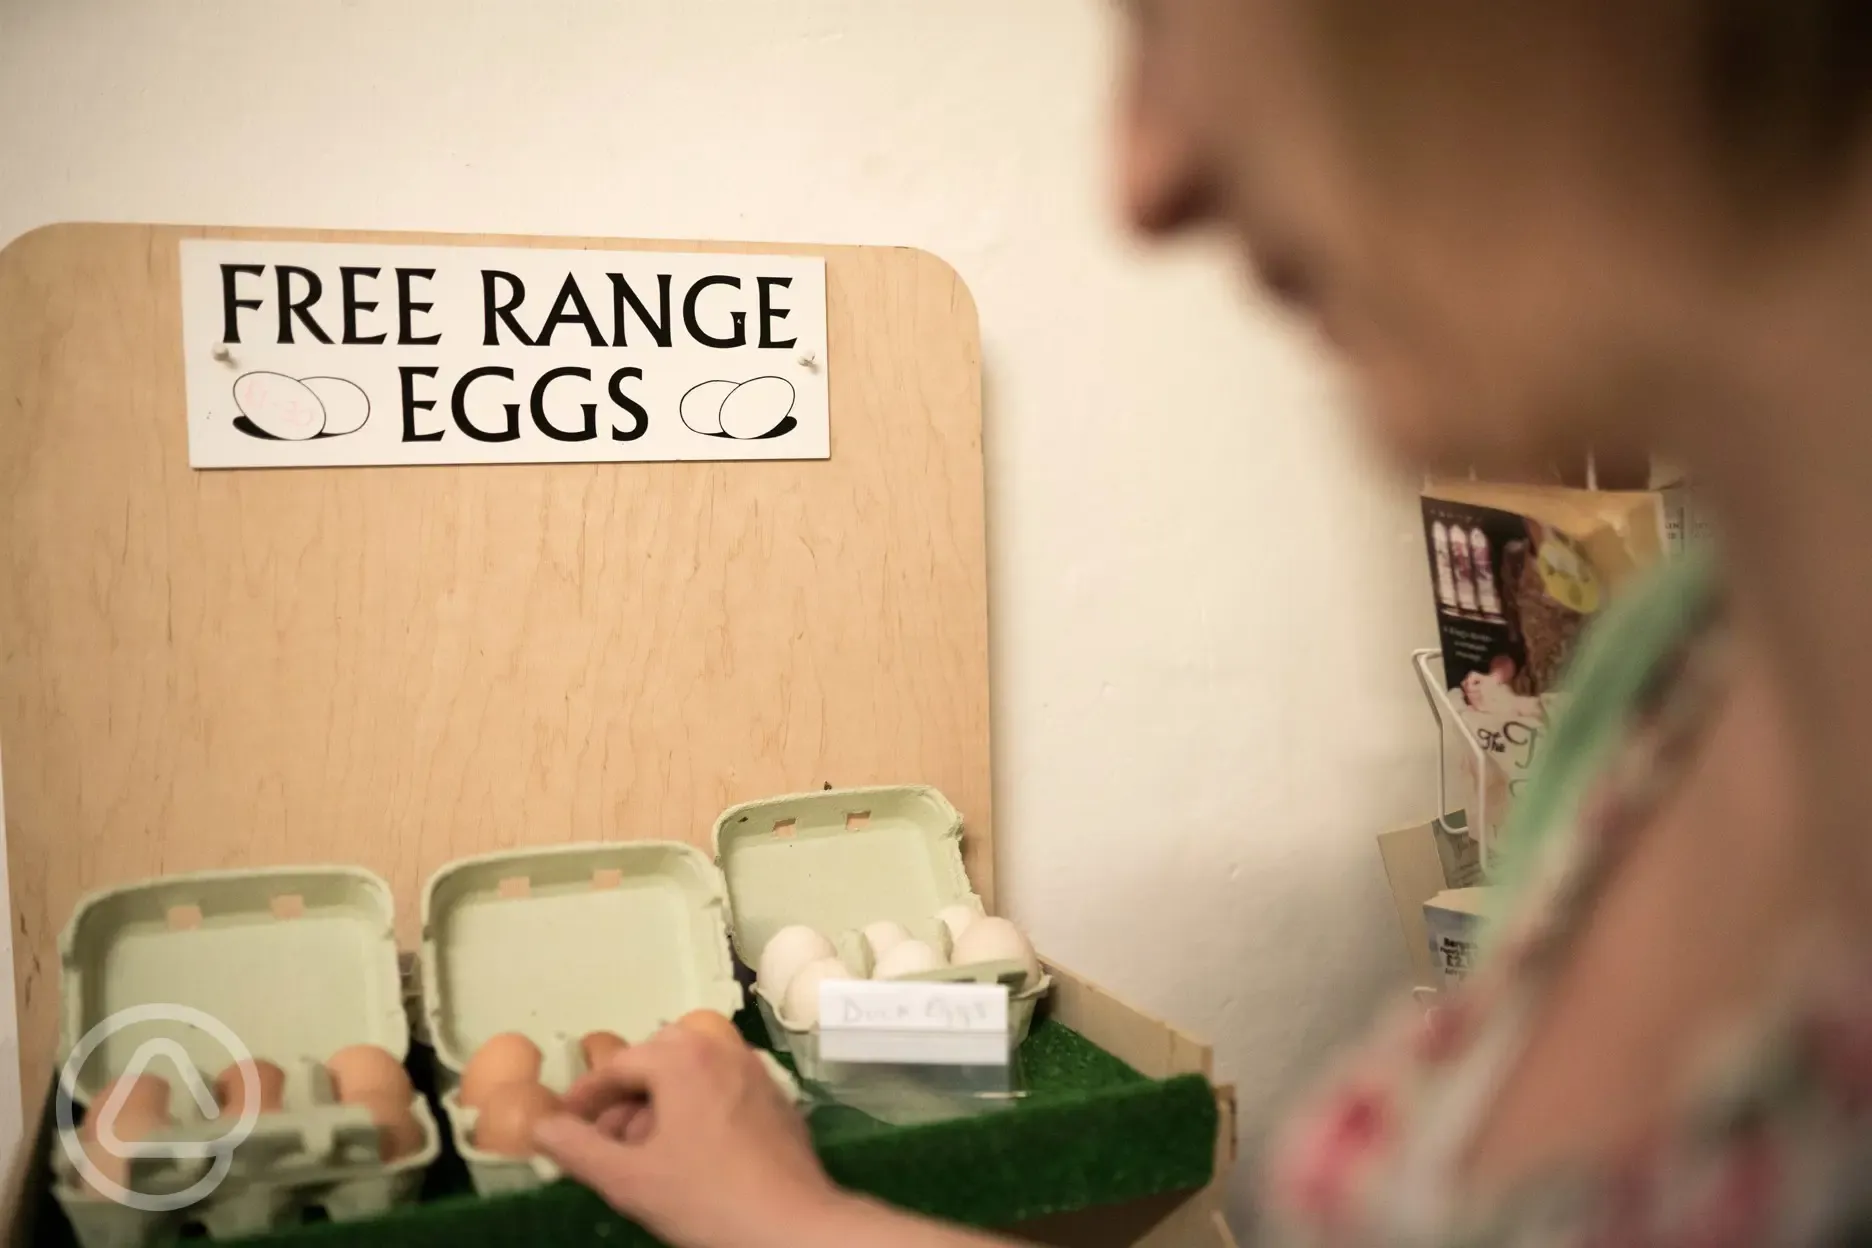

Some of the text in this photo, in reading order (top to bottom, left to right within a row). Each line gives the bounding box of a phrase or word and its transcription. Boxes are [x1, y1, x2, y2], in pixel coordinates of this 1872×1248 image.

[220, 263, 798, 349] FREE RANGE
[398, 366, 649, 443] EGGS
[1477, 727, 1506, 753] The
